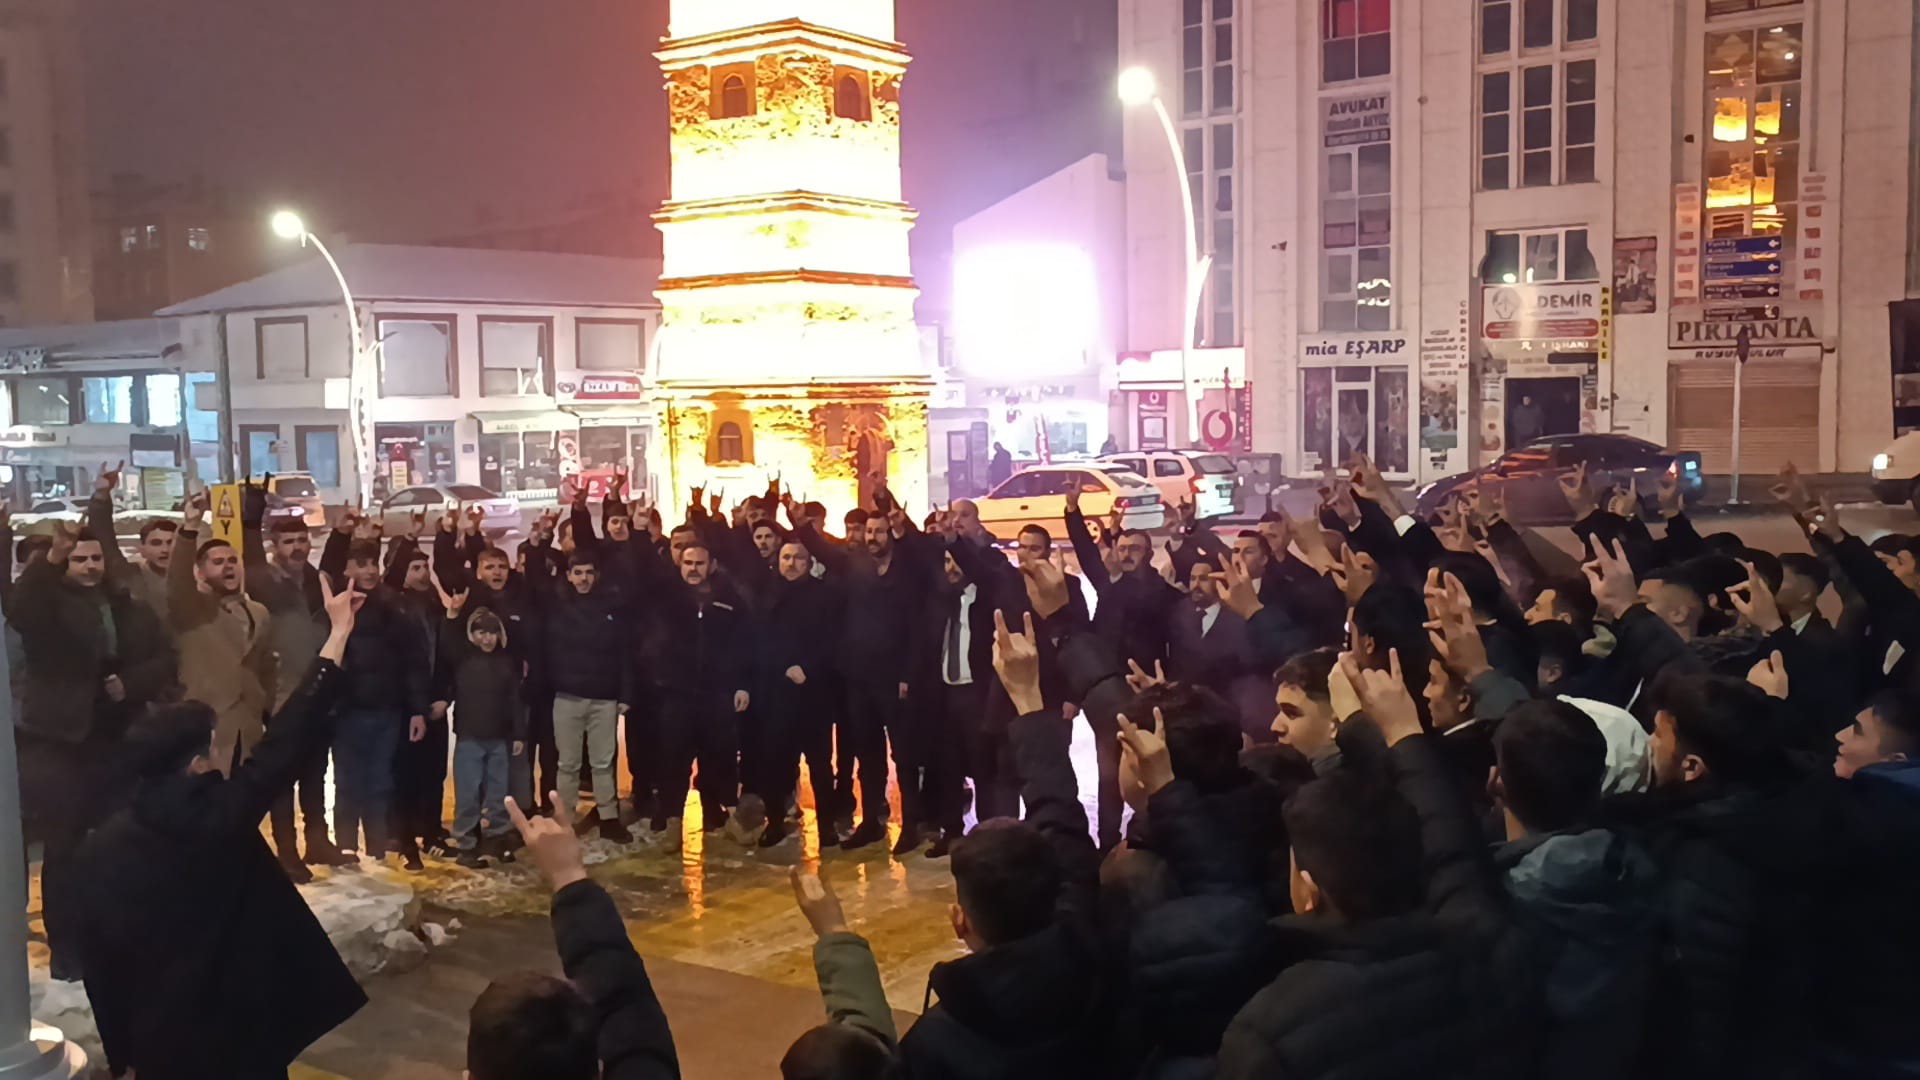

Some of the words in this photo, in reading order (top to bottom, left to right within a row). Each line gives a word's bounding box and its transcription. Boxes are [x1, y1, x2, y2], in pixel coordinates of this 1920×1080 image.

[1329, 97, 1386, 116] AVUKAT
[1537, 290, 1592, 309] DEMİR
[1676, 316, 1815, 341] PIRLANTA
[1305, 340, 1338, 356] mia
[1344, 338, 1406, 359] EŞARP
